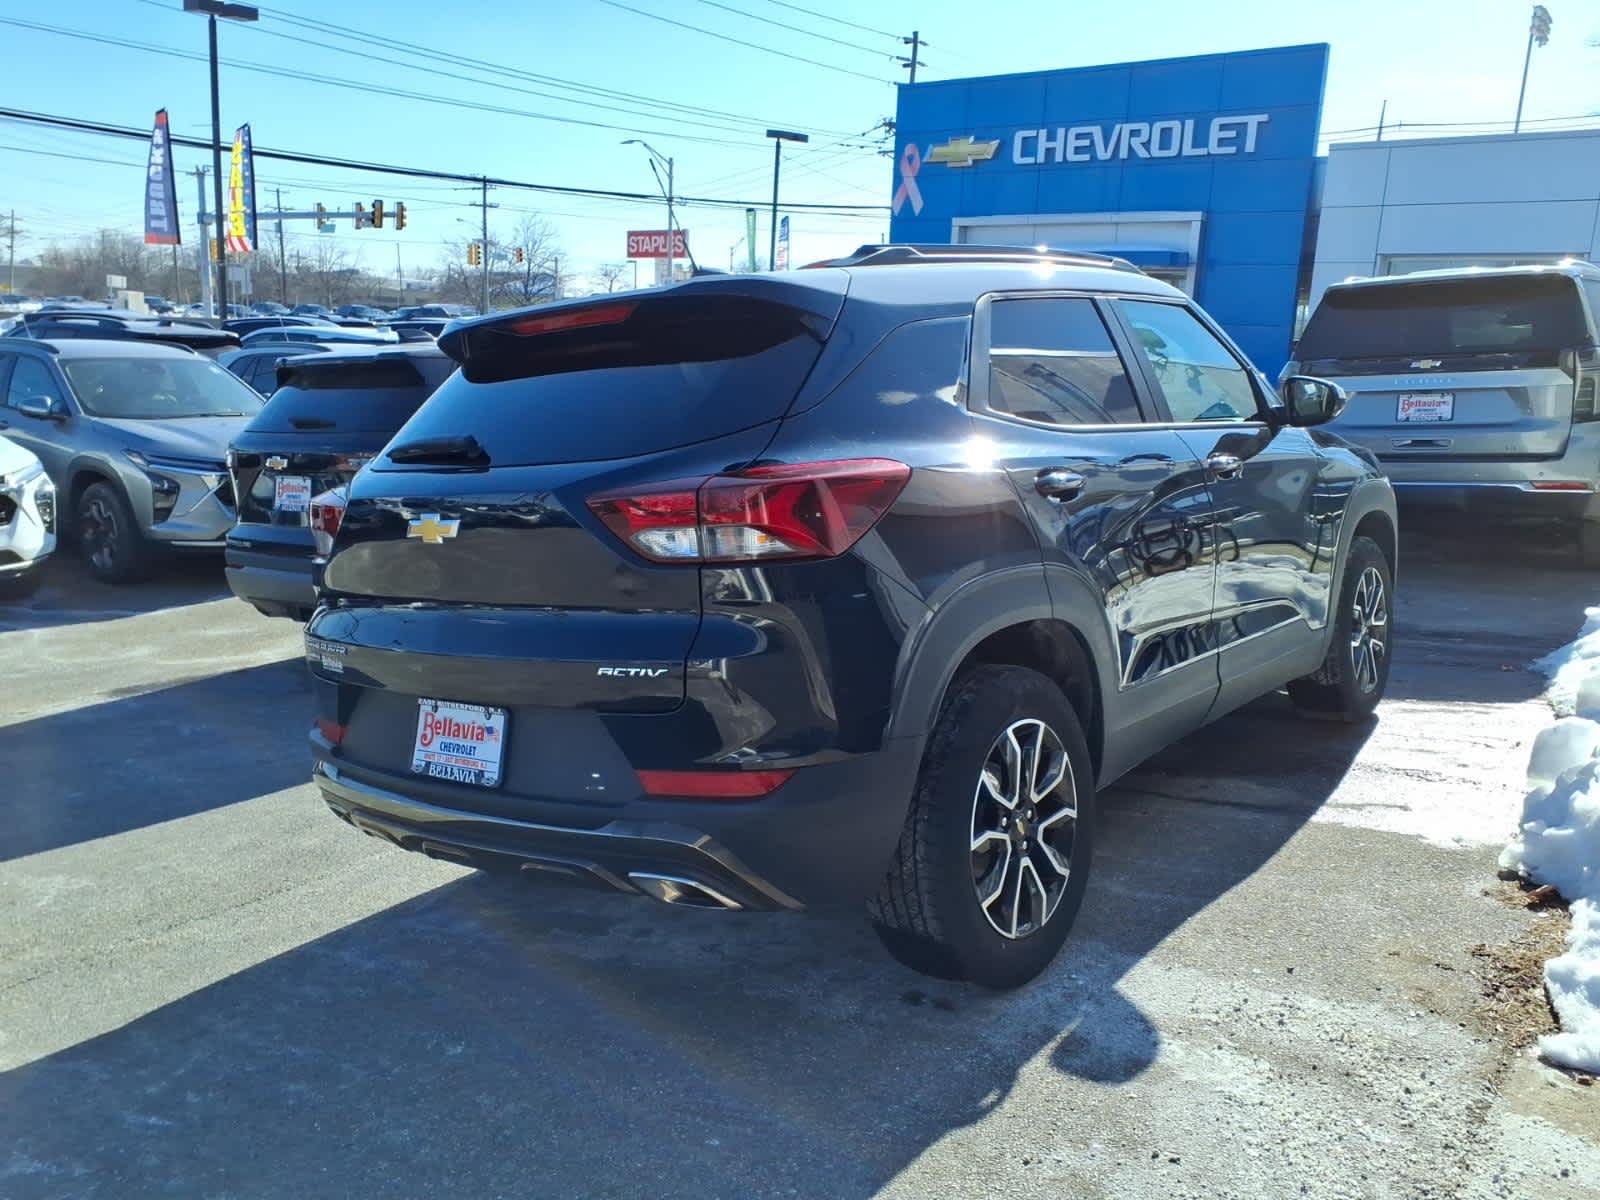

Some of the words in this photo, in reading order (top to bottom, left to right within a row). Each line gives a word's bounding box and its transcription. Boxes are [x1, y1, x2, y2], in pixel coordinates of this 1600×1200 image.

[1012, 113, 1269, 166] CHEVROLET
[597, 667, 669, 677] ACTIV
[421, 711, 485, 747] Bellavia
[439, 740, 477, 756] CHEVROLET
[429, 764, 476, 784] BELLAVIA
